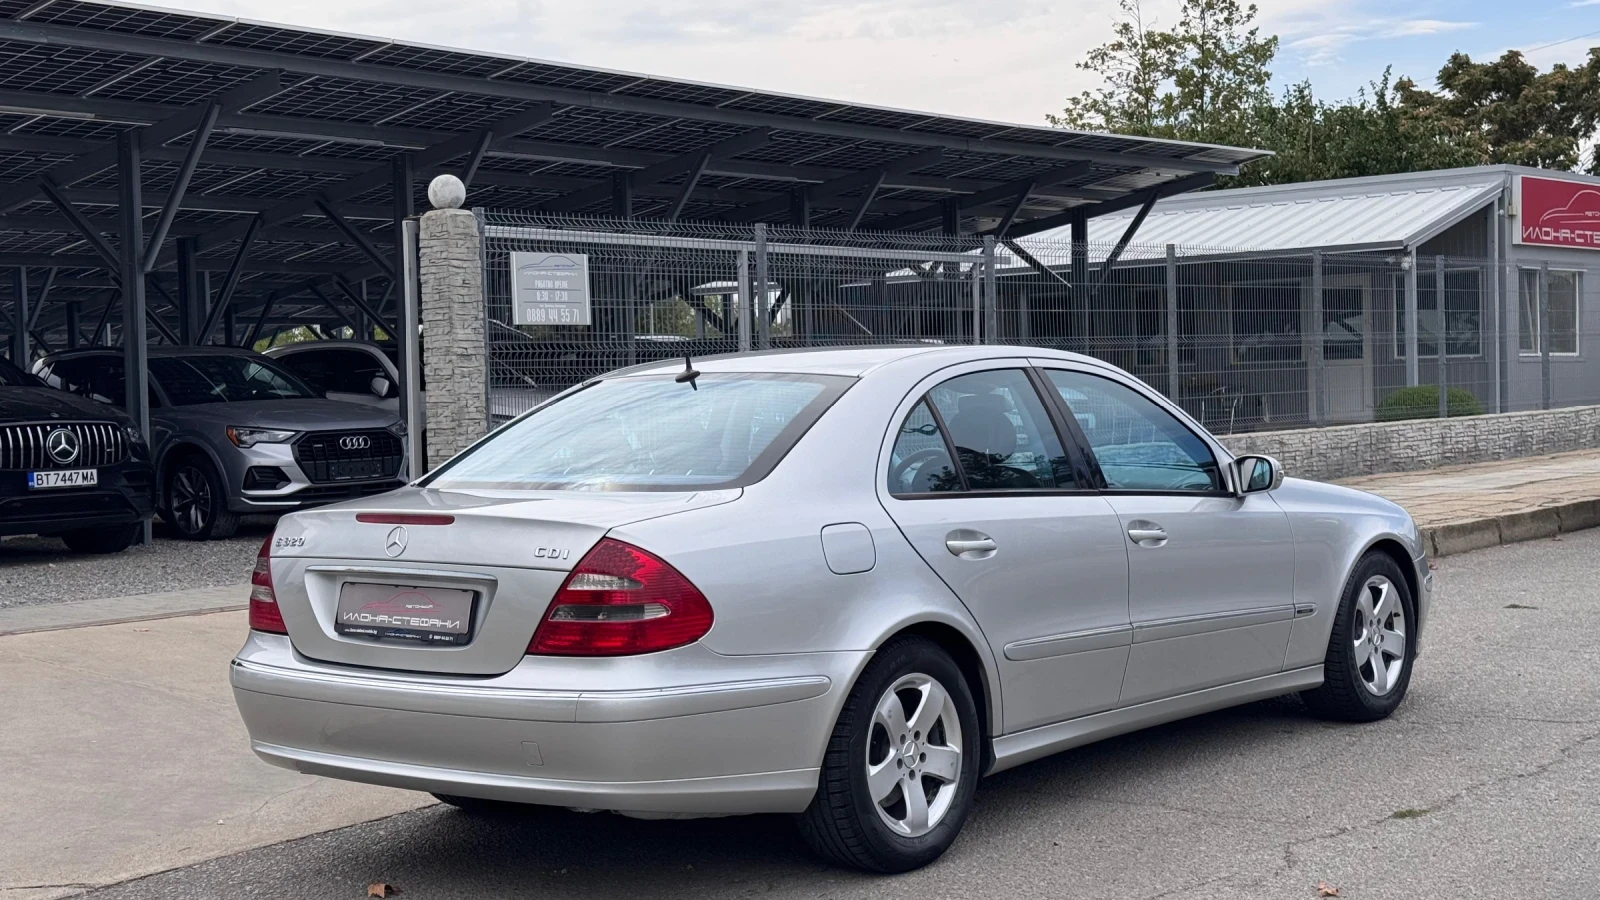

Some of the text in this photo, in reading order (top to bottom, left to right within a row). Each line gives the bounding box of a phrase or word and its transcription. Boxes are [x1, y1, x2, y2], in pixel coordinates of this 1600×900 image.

[535, 280, 569, 288] РАБОТНО ВРЕМЕ
[526, 308, 580, 323] 0889 44 55 71
[36, 471, 96, 486] BT 7447 MA
[534, 546, 570, 560] CDI
[343, 612, 460, 629] ИЛОНА-СТЕФАНИ
